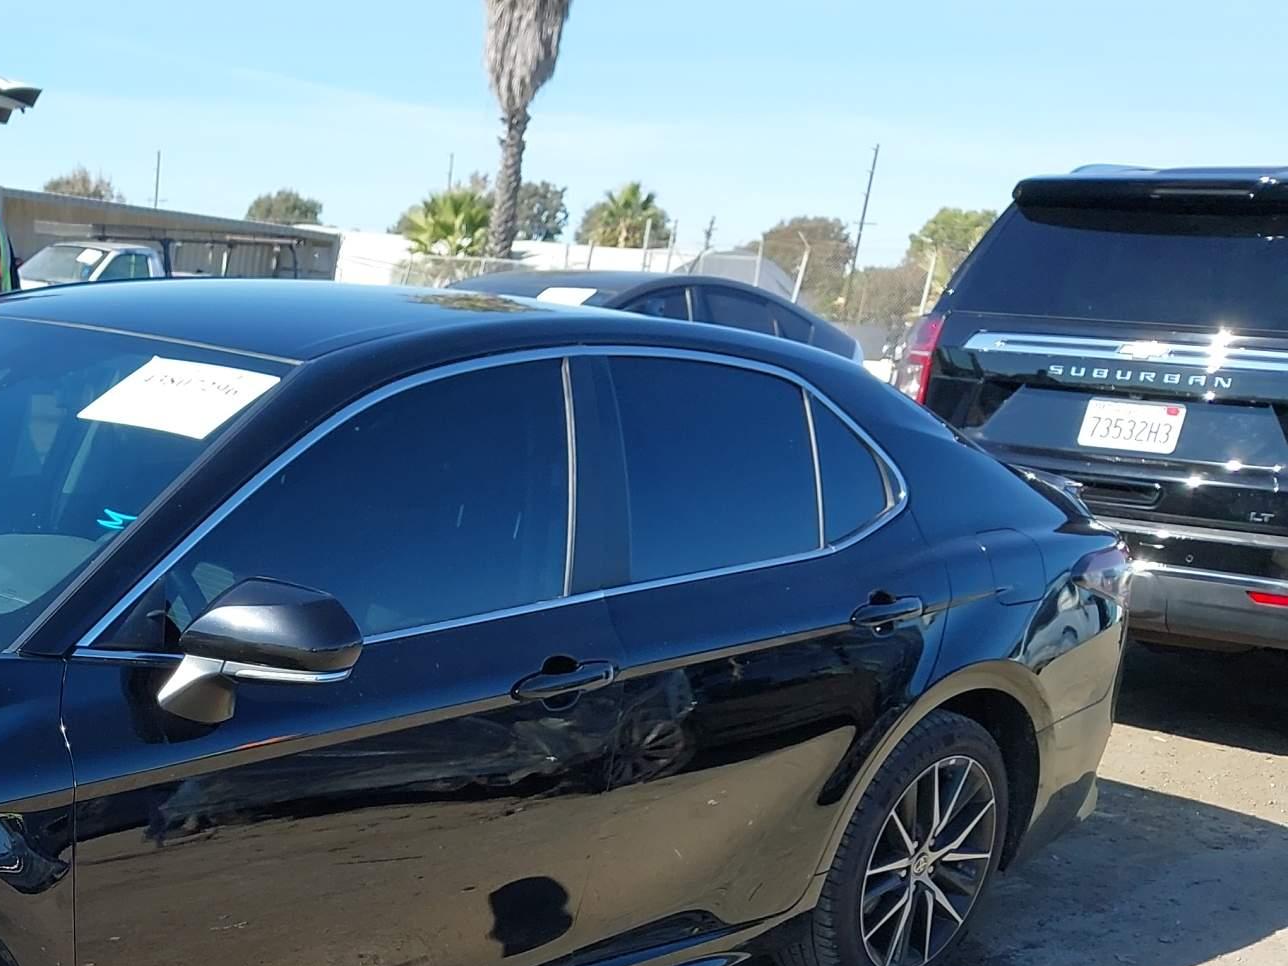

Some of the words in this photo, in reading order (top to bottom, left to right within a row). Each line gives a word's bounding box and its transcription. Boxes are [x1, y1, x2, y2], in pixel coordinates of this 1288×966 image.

[1048, 364, 1233, 388] SUBURBAN
[1090, 415, 1173, 445] 73532H3
[1249, 511, 1275, 523] LT
